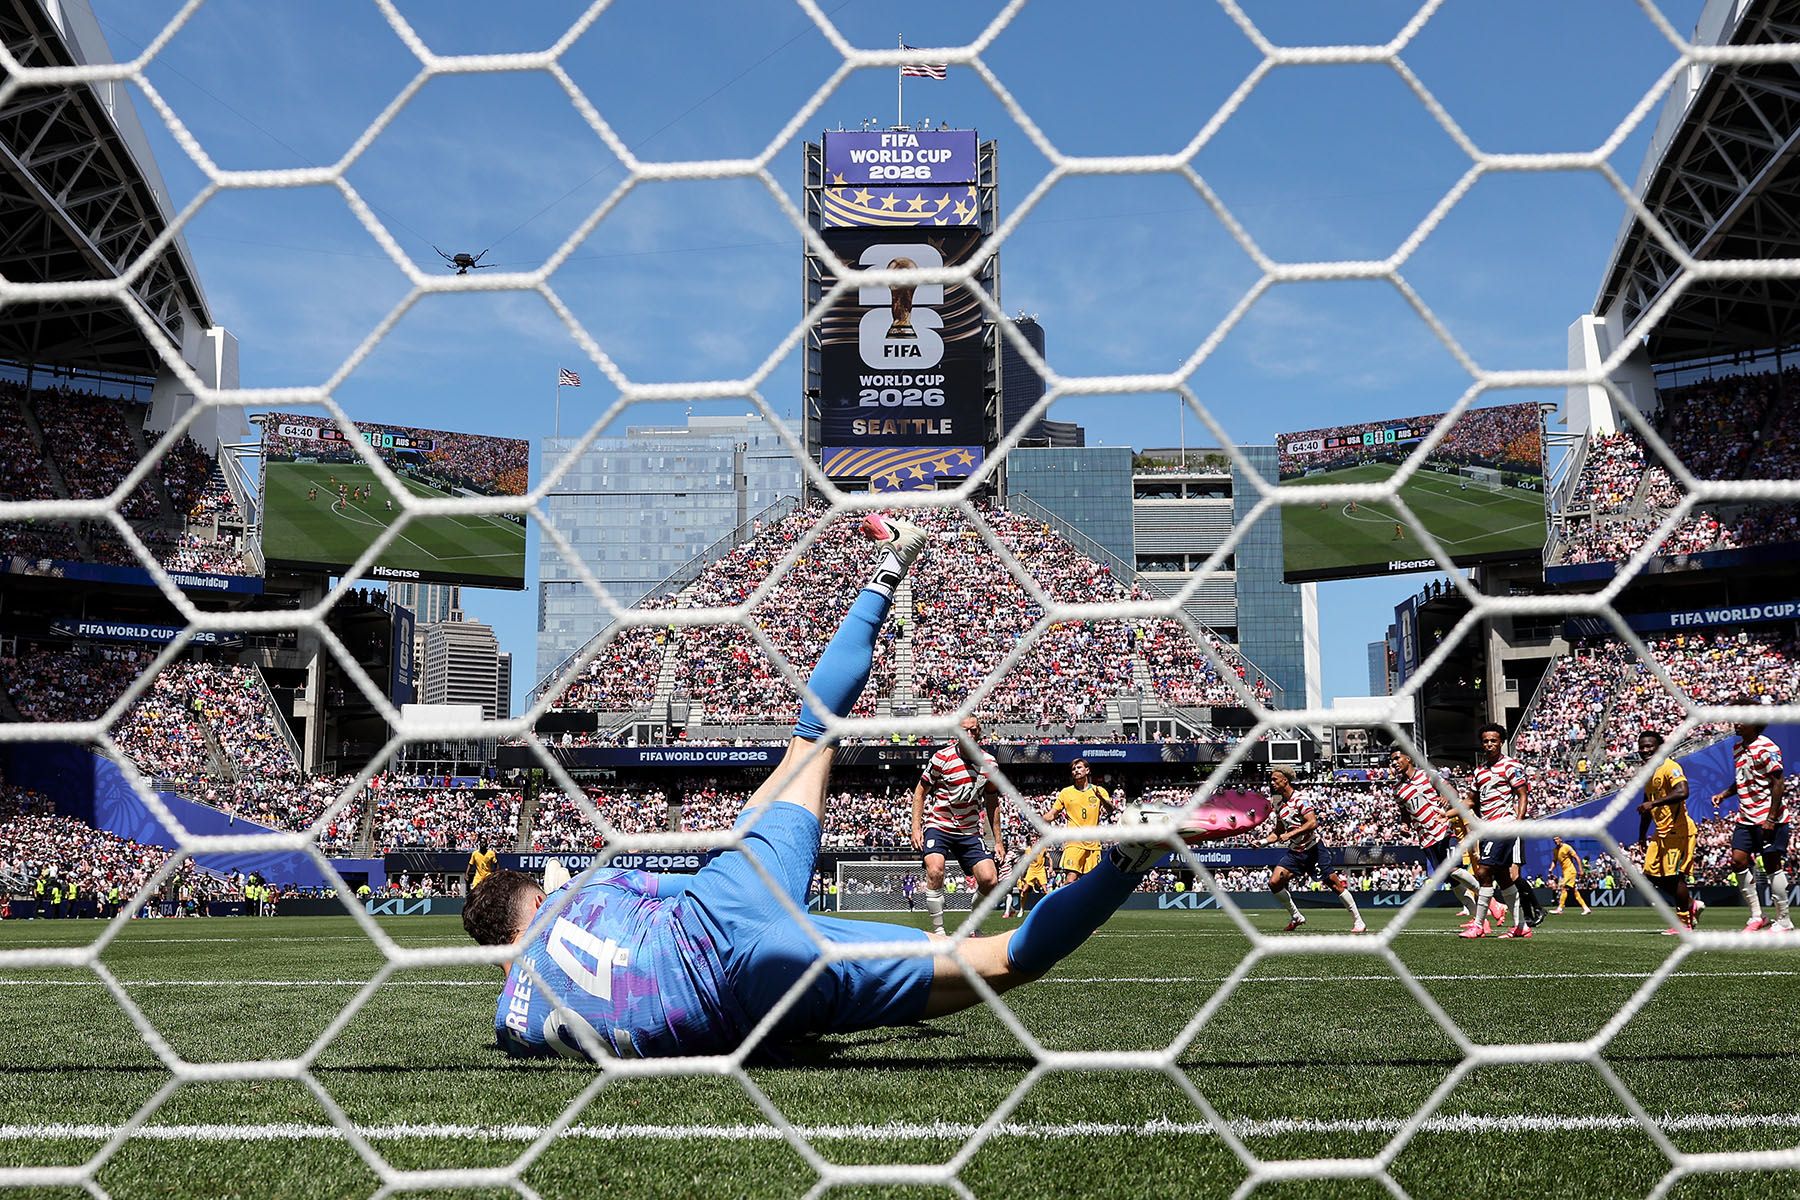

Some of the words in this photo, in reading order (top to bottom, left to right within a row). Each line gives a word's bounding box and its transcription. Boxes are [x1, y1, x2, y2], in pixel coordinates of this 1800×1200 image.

[881, 134, 919, 147] FIFA
[850, 150, 914, 163] WORLD
[916, 150, 952, 163] CUP
[869, 166, 931, 179] 2026
[884, 345, 921, 357] FIFA
[859, 375, 912, 386] WORLD
[915, 374, 945, 386] CUP
[859, 388, 945, 407] 2026
[852, 418, 952, 435] SEATTLE
[284, 426, 313, 437] 64:40
[395, 438, 409, 447] AUS
[1292, 442, 1318, 453] 64:40
[1347, 436, 1360, 445] USA
[1398, 430, 1411, 438] AUS
[1517, 481, 1536, 490] KIA
[1566, 504, 1590, 513] 300
[218, 515, 244, 524] 344
[1389, 559, 1435, 570] Hisense
[373, 566, 420, 578] Hisense
[1670, 612, 1704, 626] FIFA
[1705, 607, 1761, 623] WORLD
[1763, 604, 1795, 618] CUP
[79, 624, 104, 635] FIFA
[106, 626, 149, 638] WORLD
[150, 629, 174, 639] CUP
[639, 752, 663, 761] FIFA
[664, 752, 704, 761] WORLD
[705, 752, 728, 761] CUP
[729, 752, 768, 761] 2026
[878, 750, 929, 760] SEATTLE
[1082, 749, 1127, 758] #FIFAWorldCup
[1410, 797, 1419, 810] 17
[1081, 808, 1087, 819] 8
[1484, 841, 1493, 855] 4
[613, 856, 643, 868] CUP
[645, 856, 700, 868] 2026
[1667, 851, 1677, 865] 17
[1590, 890, 1625, 907] KIA
[365, 898, 432, 915] KIA
[505, 955, 537, 1048] FREESE
